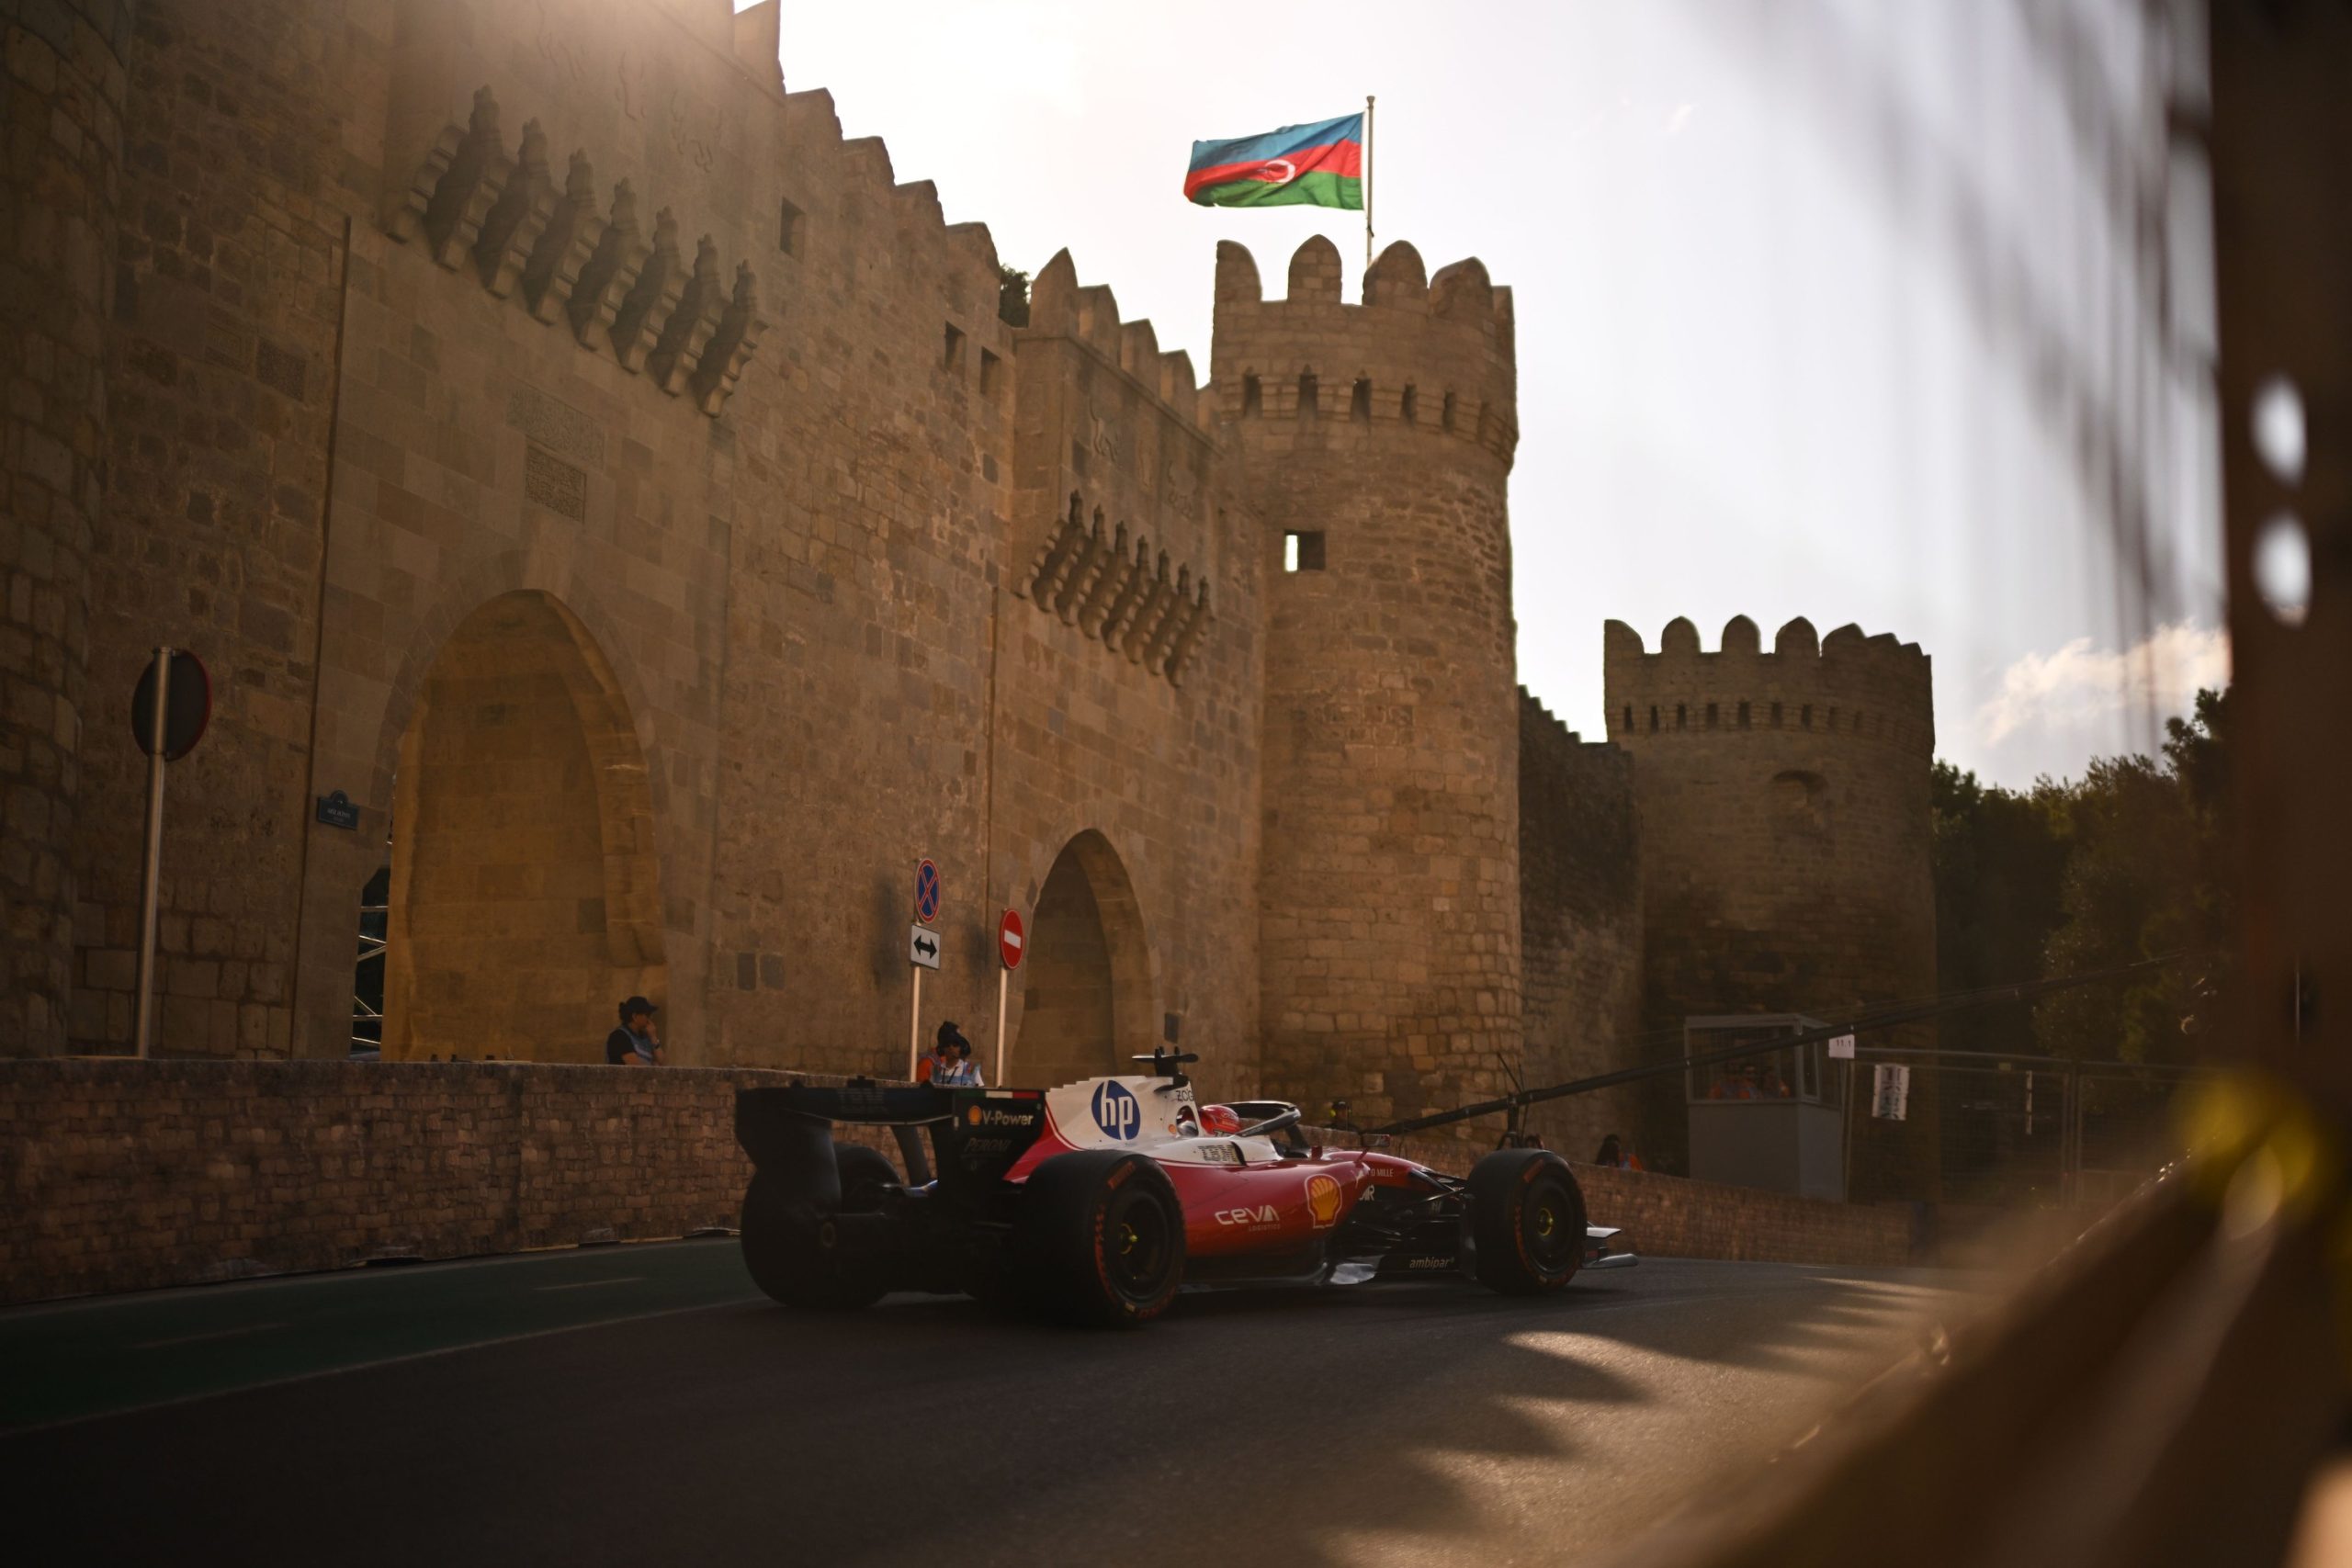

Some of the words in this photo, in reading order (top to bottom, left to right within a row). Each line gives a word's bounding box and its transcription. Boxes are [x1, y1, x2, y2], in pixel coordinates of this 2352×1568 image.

[982, 1109, 1035, 1126] V-Power
[1101, 1080, 1134, 1141] hp
[1198, 1145, 1238, 1162] IBM
[1409, 1256, 1449, 1270] ambipar
